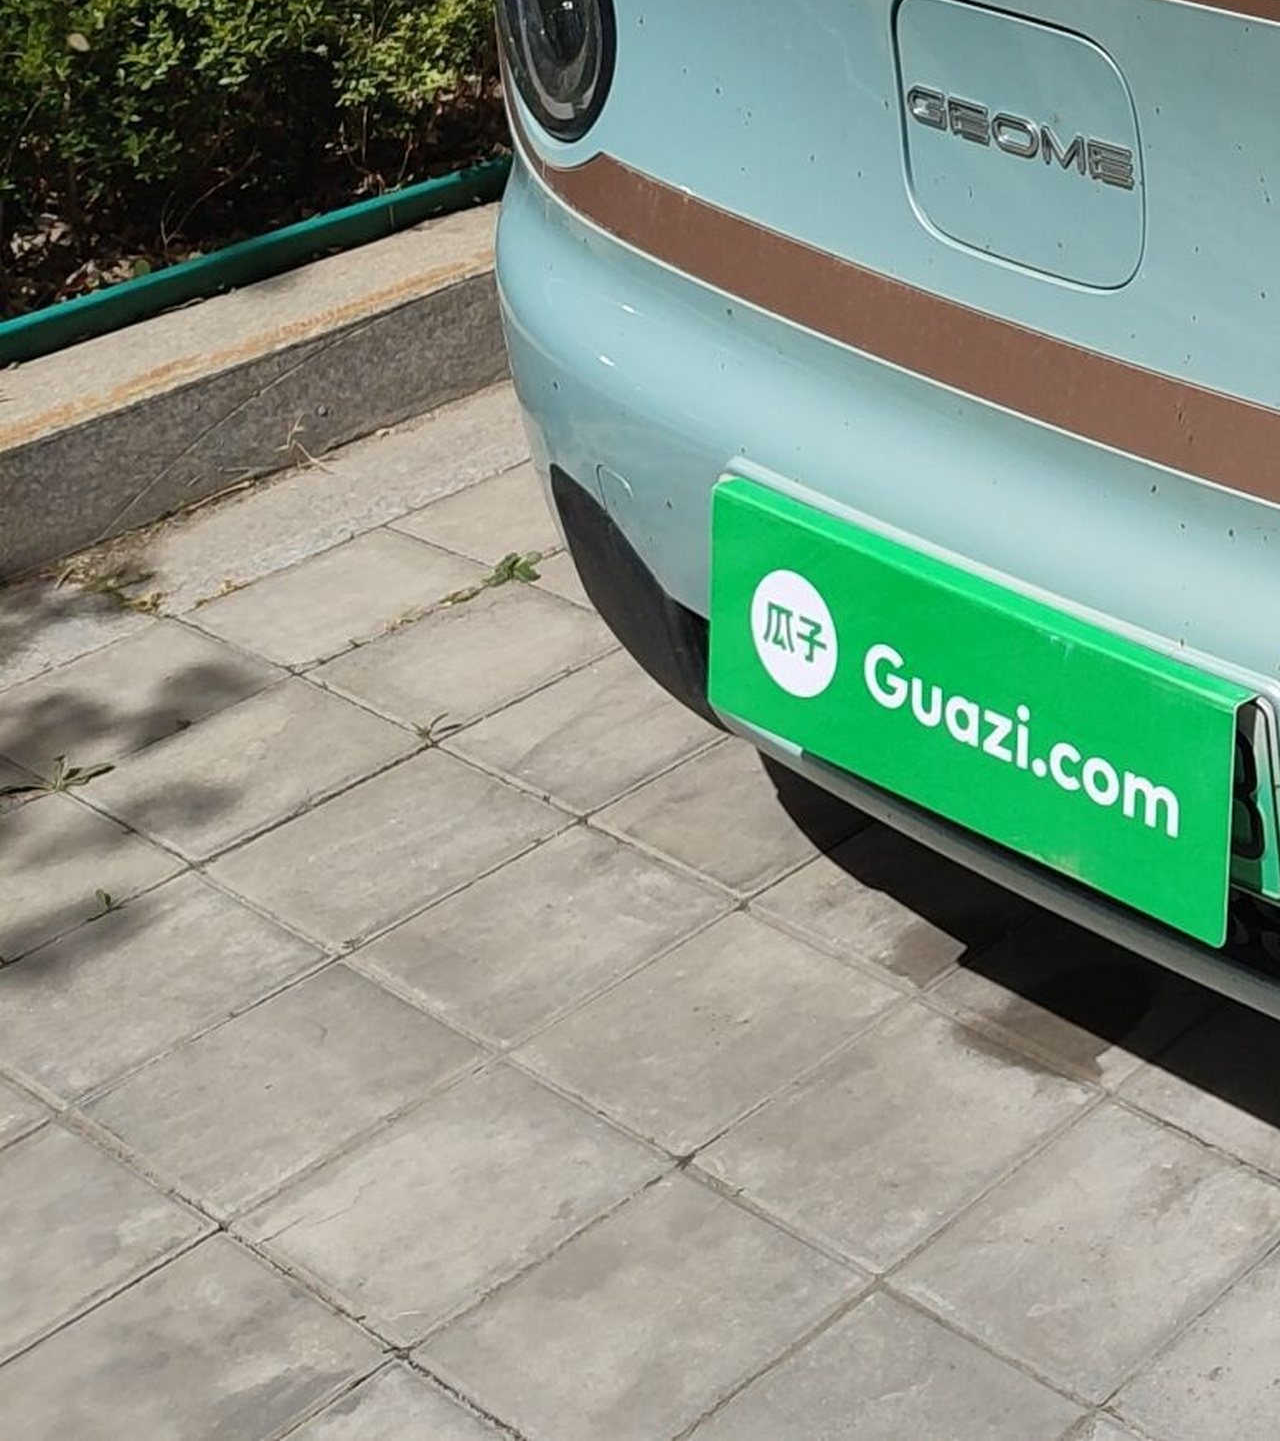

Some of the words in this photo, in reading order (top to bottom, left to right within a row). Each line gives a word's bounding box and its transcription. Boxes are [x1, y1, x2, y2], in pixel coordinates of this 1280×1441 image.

[907, 85, 1134, 190] GEOME
[763, 600, 828, 663] 瓜子
[863, 642, 1180, 839] Guazi.com
